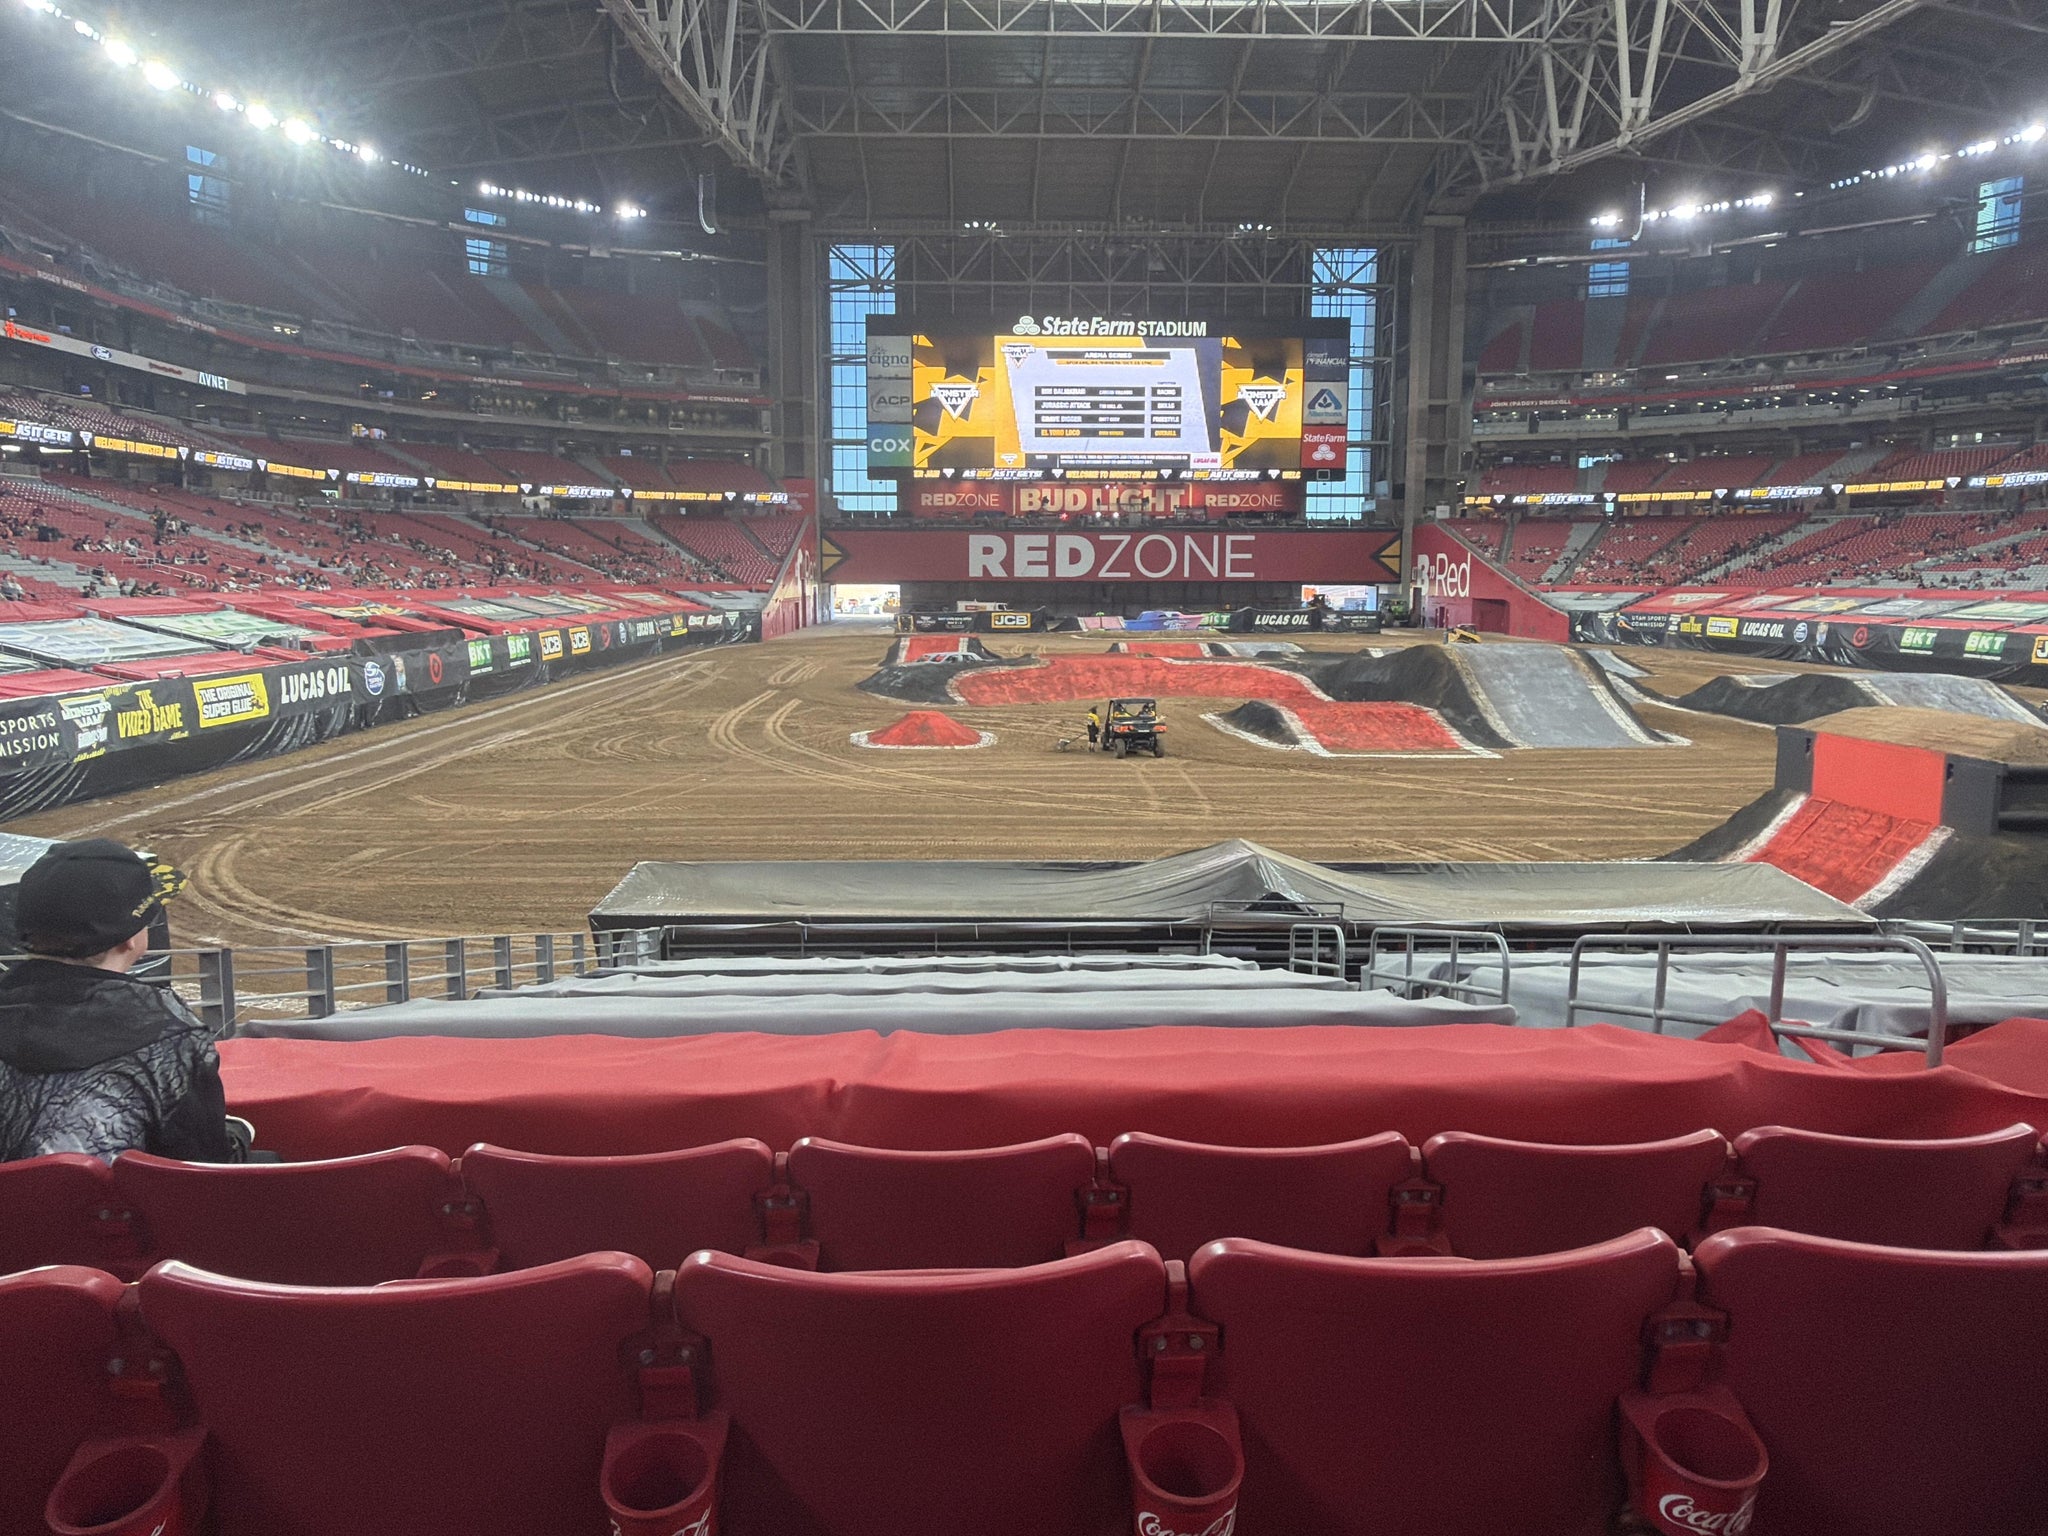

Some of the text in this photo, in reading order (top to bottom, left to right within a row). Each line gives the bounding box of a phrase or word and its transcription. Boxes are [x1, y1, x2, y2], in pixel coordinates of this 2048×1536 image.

[1138, 322, 1207, 337] STADIUM
[869, 352, 909, 368] cigna
[199, 371, 229, 391] AVNET
[876, 396, 910, 405] ACP
[930, 389, 979, 398] MONSTER
[1238, 390, 1287, 399] MONSTER
[16, 424, 30, 436] AS
[31, 426, 43, 437] IT
[43, 428, 72, 443] GETS!
[871, 438, 910, 452] COX
[1066, 470, 1099, 478] WELCOME
[1109, 470, 1141, 479] MONSTER
[1141, 470, 1158, 479] JAM
[1970, 477, 1986, 486] AS
[2003, 475, 2017, 485] AS
[1845, 484, 1880, 494] WELCOME
[1890, 481, 1926, 492] MONSTER
[1926, 479, 1945, 490] JAM
[1019, 488, 1185, 512] BUD LIGHT
[1618, 493, 1652, 502] WELCOME
[1662, 491, 1696, 501] MONSTER
[1695, 491, 1713, 500] JAM
[968, 534, 1256, 578] REDZONE
[1436, 552, 1471, 598] Red
[994, 615, 1028, 625] JCB
[1254, 615, 1290, 626] LUCAS
[1291, 614, 1309, 625] OIL
[1742, 622, 1770, 637] LUCAS
[1769, 624, 1784, 638] OIL
[507, 637, 530, 656] BKT
[543, 636, 561, 655] JCB
[572, 632, 589, 649] JCB
[1901, 632, 1938, 646] BKT
[1965, 636, 2006, 650] BKT
[468, 643, 491, 664] BKT
[200, 682, 255, 702] THE ORIGINAL
[281, 666, 352, 705] LUCAS OIL
[61, 701, 112, 721] MONSTER
[203, 697, 253, 719] SUPER GLUE
[0, 712, 56, 735] SPORTS
[117, 709, 151, 738] VIDEO
[153, 703, 183, 732] GAME
